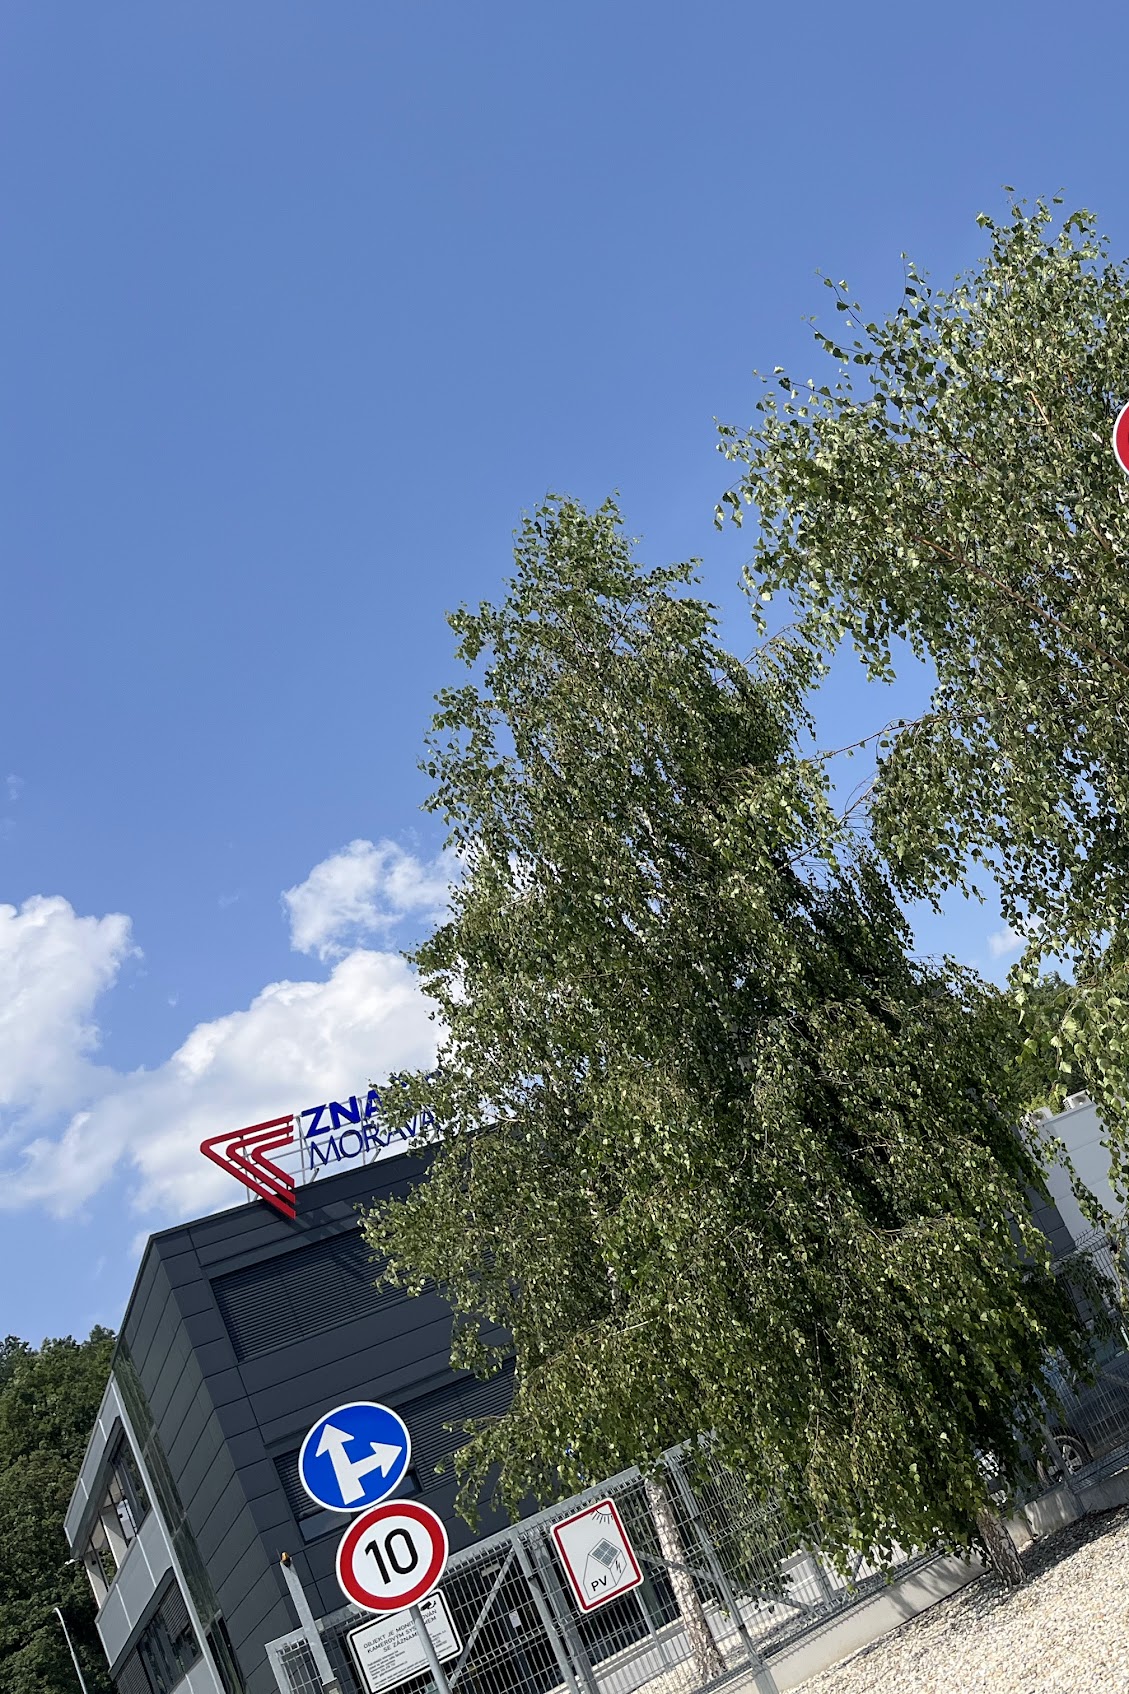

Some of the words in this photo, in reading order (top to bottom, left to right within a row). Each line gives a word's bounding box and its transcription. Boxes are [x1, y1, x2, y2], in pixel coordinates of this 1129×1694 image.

[301, 1074, 410, 1138] ZNA
[365, 1528, 418, 1585] 10
[591, 1575, 607, 1591] PV
[363, 1634, 386, 1649] OBJEKT
[387, 1629, 395, 1638] JE
[393, 1632, 417, 1648] ZÁZNAM
